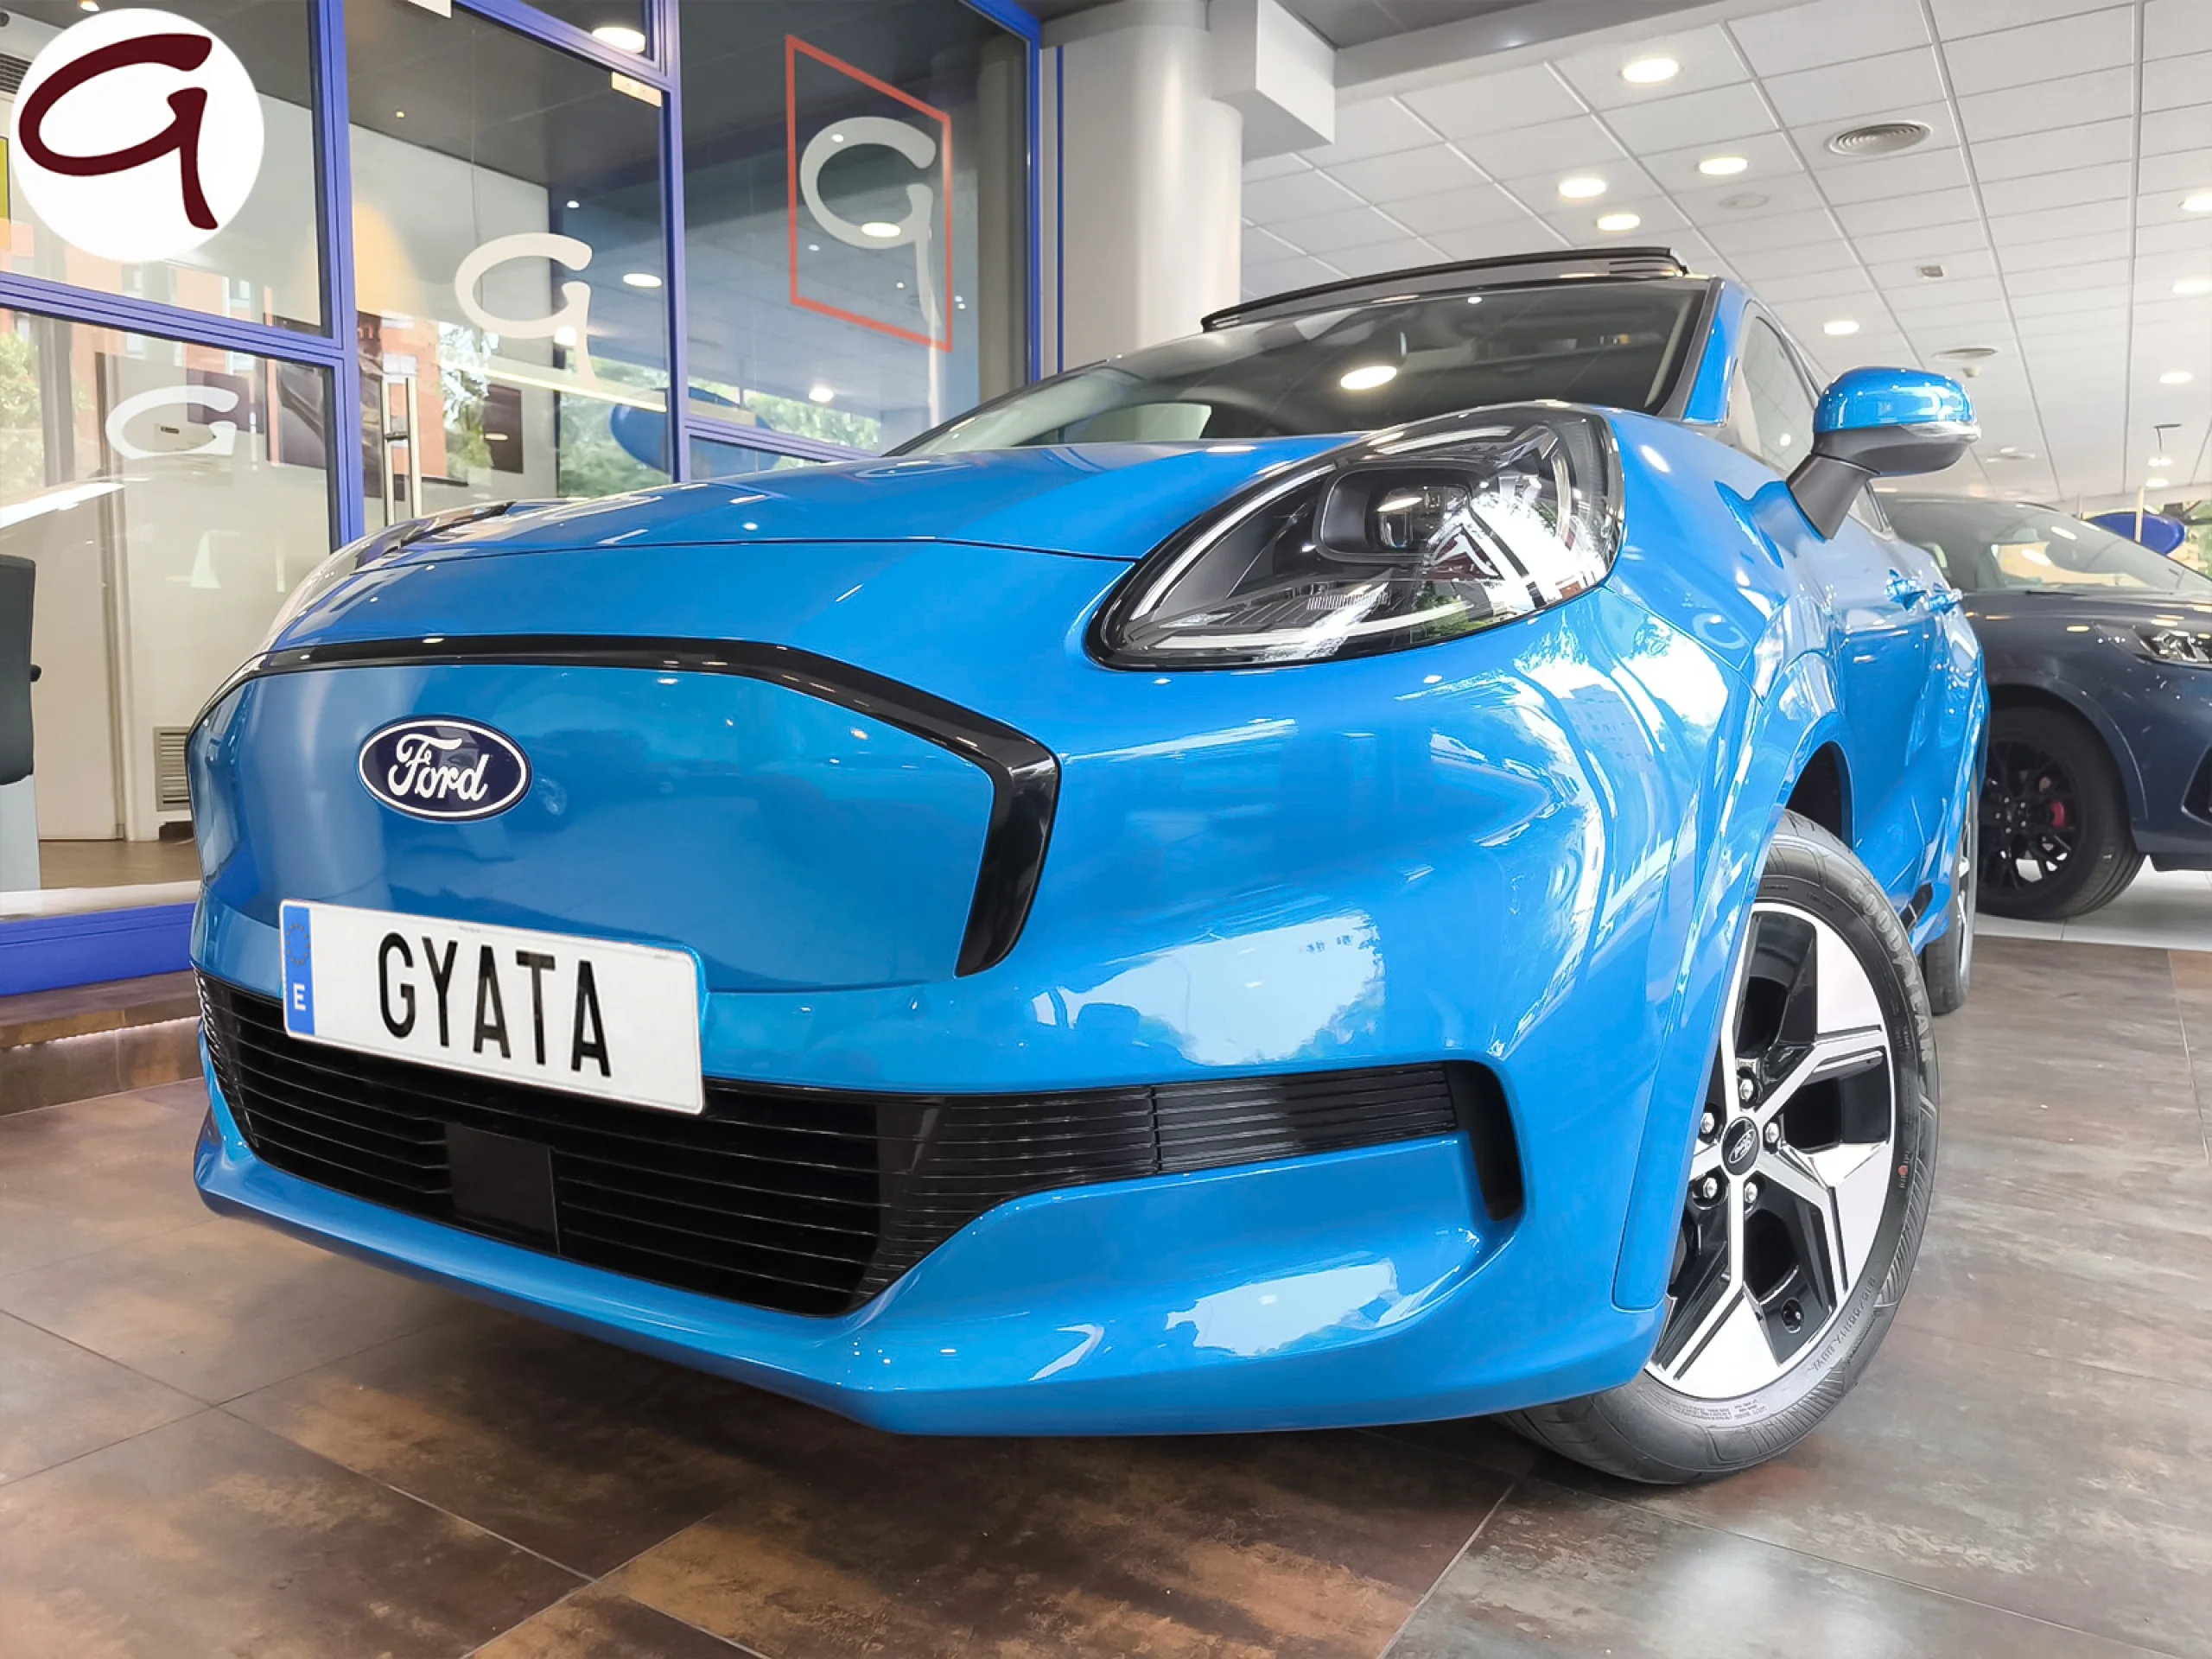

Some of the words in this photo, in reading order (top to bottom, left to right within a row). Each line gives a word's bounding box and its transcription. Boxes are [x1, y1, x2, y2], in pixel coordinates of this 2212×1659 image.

[387, 733, 490, 802] Ford
[294, 982, 307, 1012] E
[378, 932, 612, 1077] GYATA
